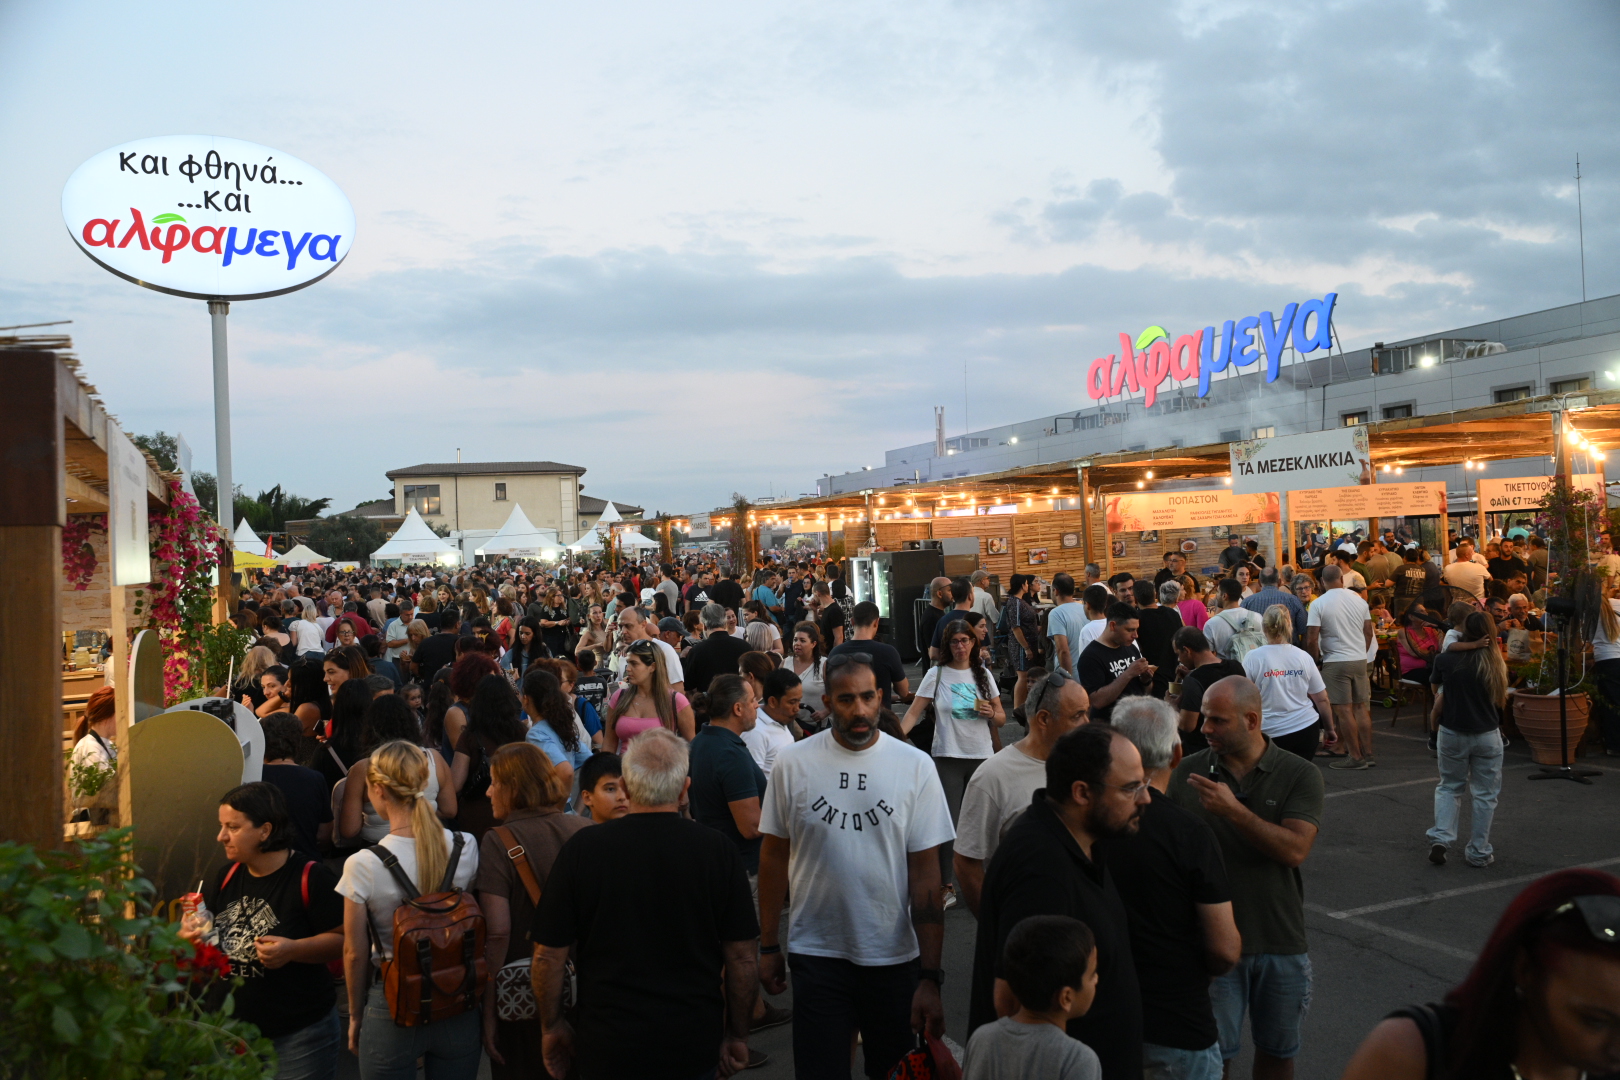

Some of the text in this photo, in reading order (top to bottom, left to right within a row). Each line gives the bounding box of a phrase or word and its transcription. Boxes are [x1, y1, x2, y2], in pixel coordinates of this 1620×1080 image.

[119, 149, 303, 191] και φθηνά...
[177, 190, 252, 213] ...και
[82, 207, 342, 271] αλφαμεγα
[1087, 292, 1338, 408] αλφαμεγα
[1238, 450, 1355, 475] ΤΑ ΜΕΖΕΚΛΙΚΚΙΑ
[1168, 495, 1218, 505] ΠΟΠΑΣΤΟΝ
[839, 772, 867, 791] BE
[811, 795, 894, 832] UNIQUE
